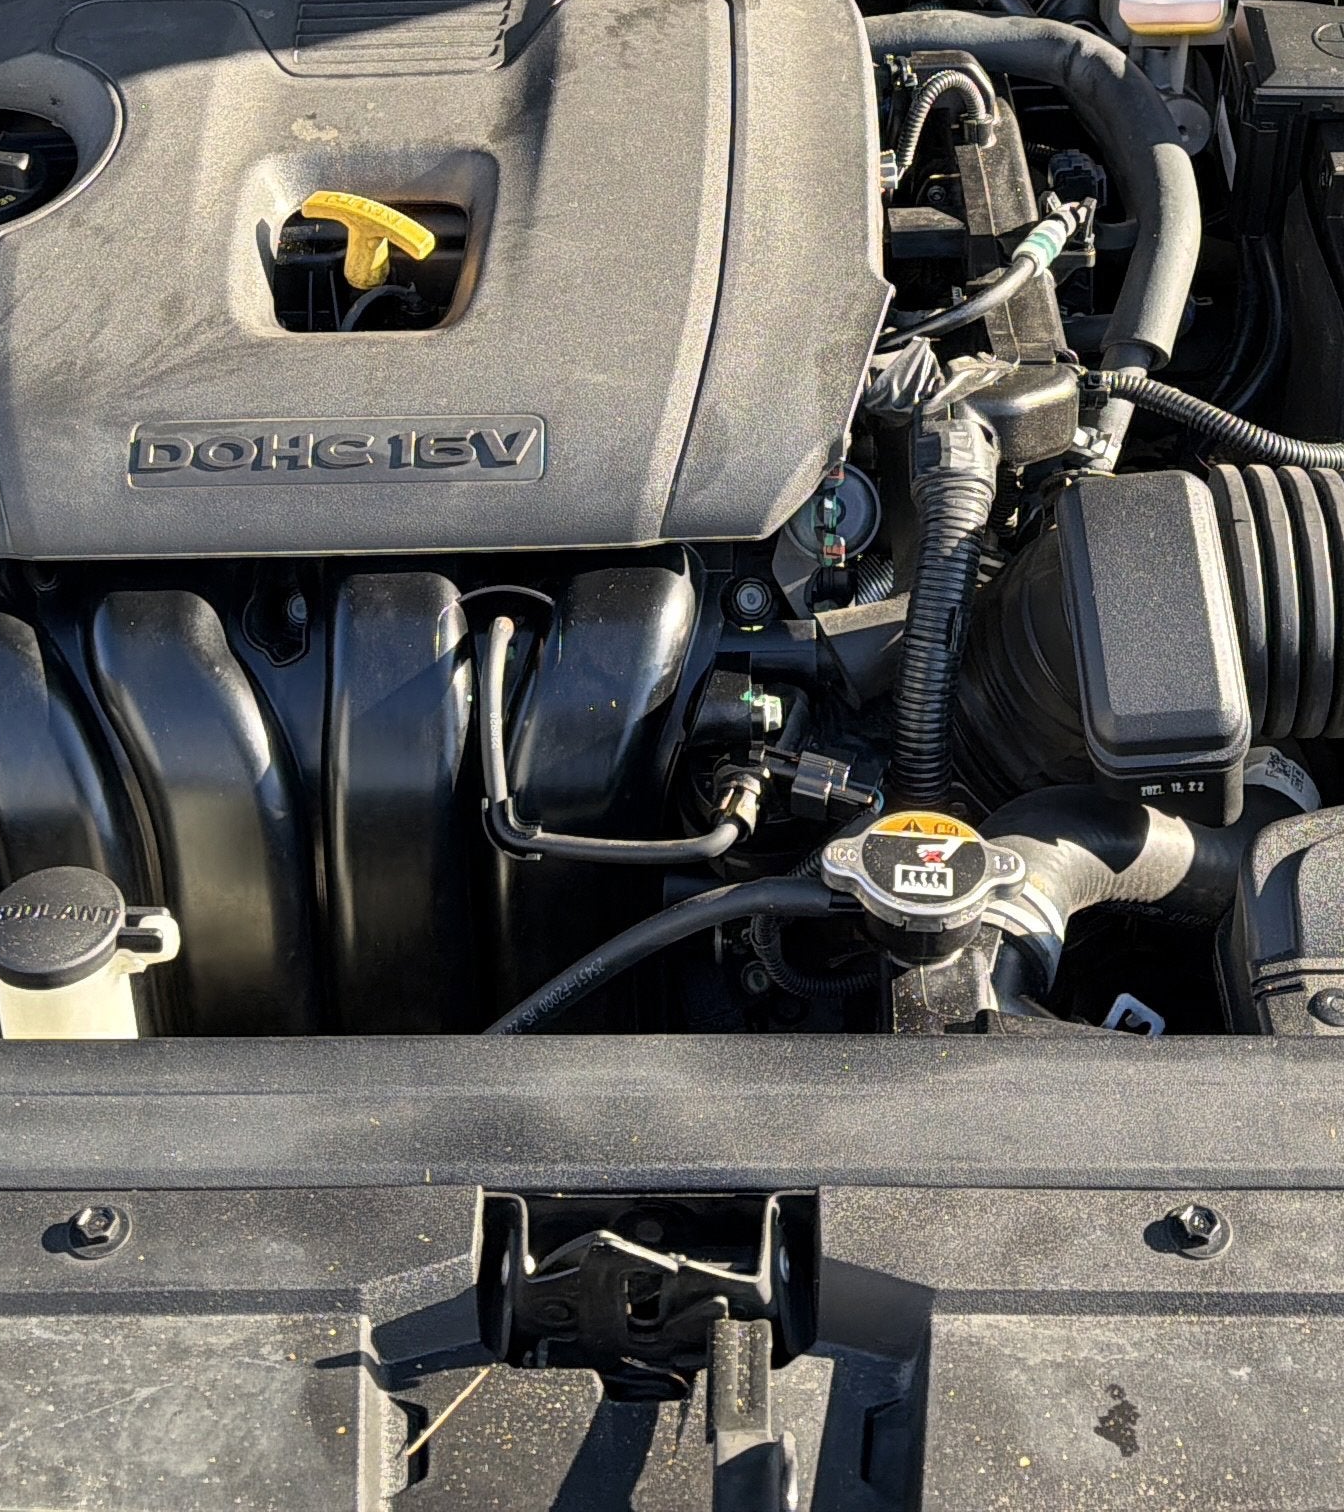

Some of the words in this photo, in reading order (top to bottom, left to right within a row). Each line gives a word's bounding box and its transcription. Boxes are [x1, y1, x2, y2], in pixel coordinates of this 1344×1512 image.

[131, 432, 375, 472] DOHC
[387, 427, 538, 470] 16V
[993, 854, 1016, 871] 1.1
